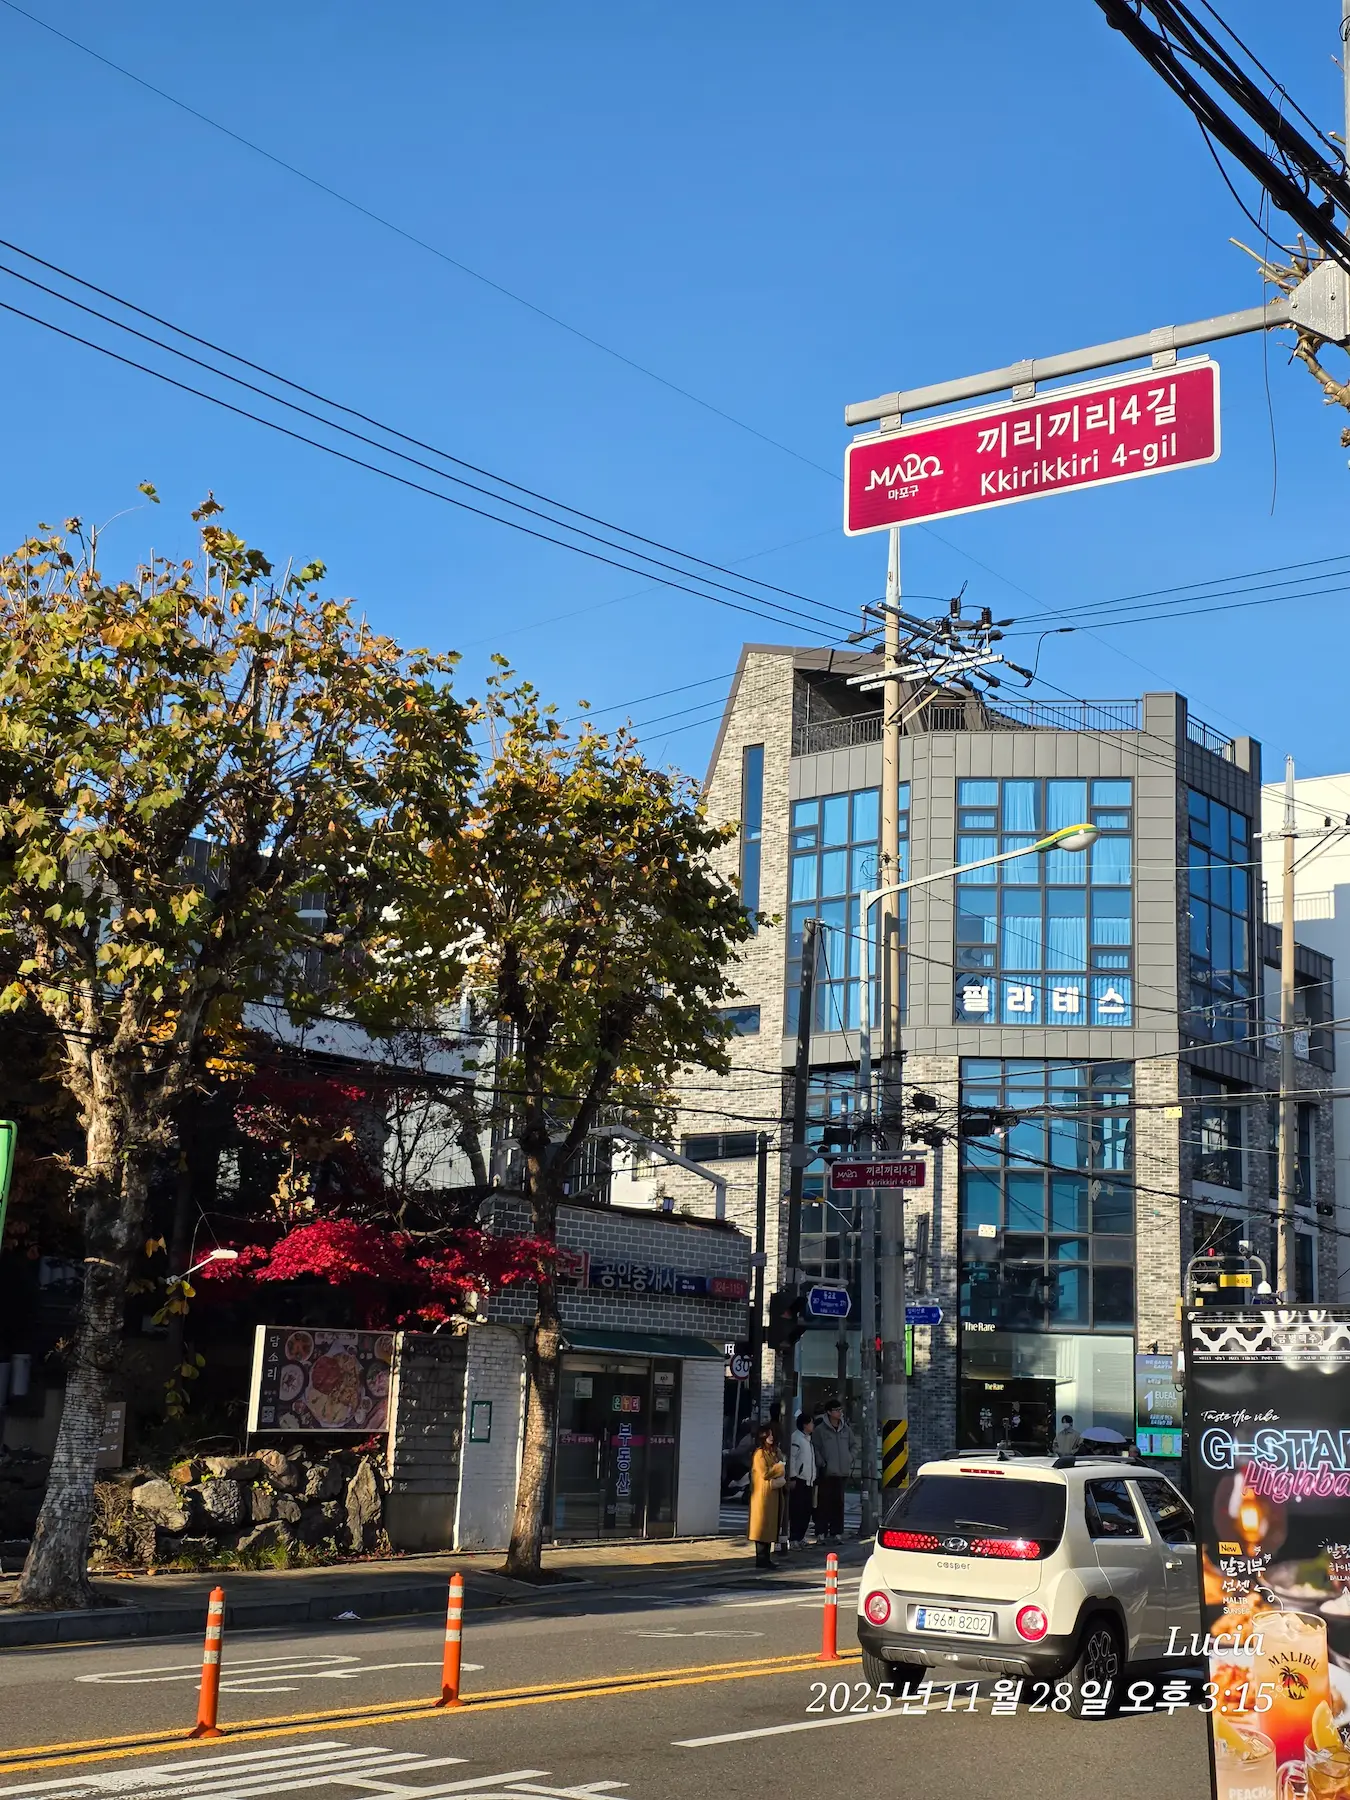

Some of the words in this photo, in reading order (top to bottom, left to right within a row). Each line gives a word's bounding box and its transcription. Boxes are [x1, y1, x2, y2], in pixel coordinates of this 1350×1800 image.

[976, 383, 1177, 458] 끼리끼리4길
[864, 453, 943, 490] MAPO
[981, 449, 1099, 497] Kkirikkiri
[1111, 432, 1178, 472] 4-gil
[887, 486, 919, 501] 마포구
[963, 985, 1125, 1013] 필라테스
[865, 1165, 917, 1177] 끼리끼리4길
[866, 1179, 898, 1187] Kkirikkiri
[900, 1178, 917, 1187] 4-gil
[600, 1261, 678, 1293] 공인중개사
[964, 1322, 978, 1332] The
[978, 1322, 995, 1332] Rare
[267, 1336, 280, 1380] 담소리
[735, 1358, 749, 1372] 30
[612, 1395, 640, 1412] 온누리
[1201, 1410, 1231, 1422] Taste
[1230, 1409, 1251, 1427] the
[1254, 1409, 1280, 1421] vibe
[616, 1423, 632, 1497] 부동산
[1221, 1544, 1237, 1554] New
[937, 1560, 970, 1570] casper
[1220, 1556, 1266, 1577] 말리부
[1222, 1579, 1250, 1593] 선셋
[959, 1616, 987, 1631] 8202
